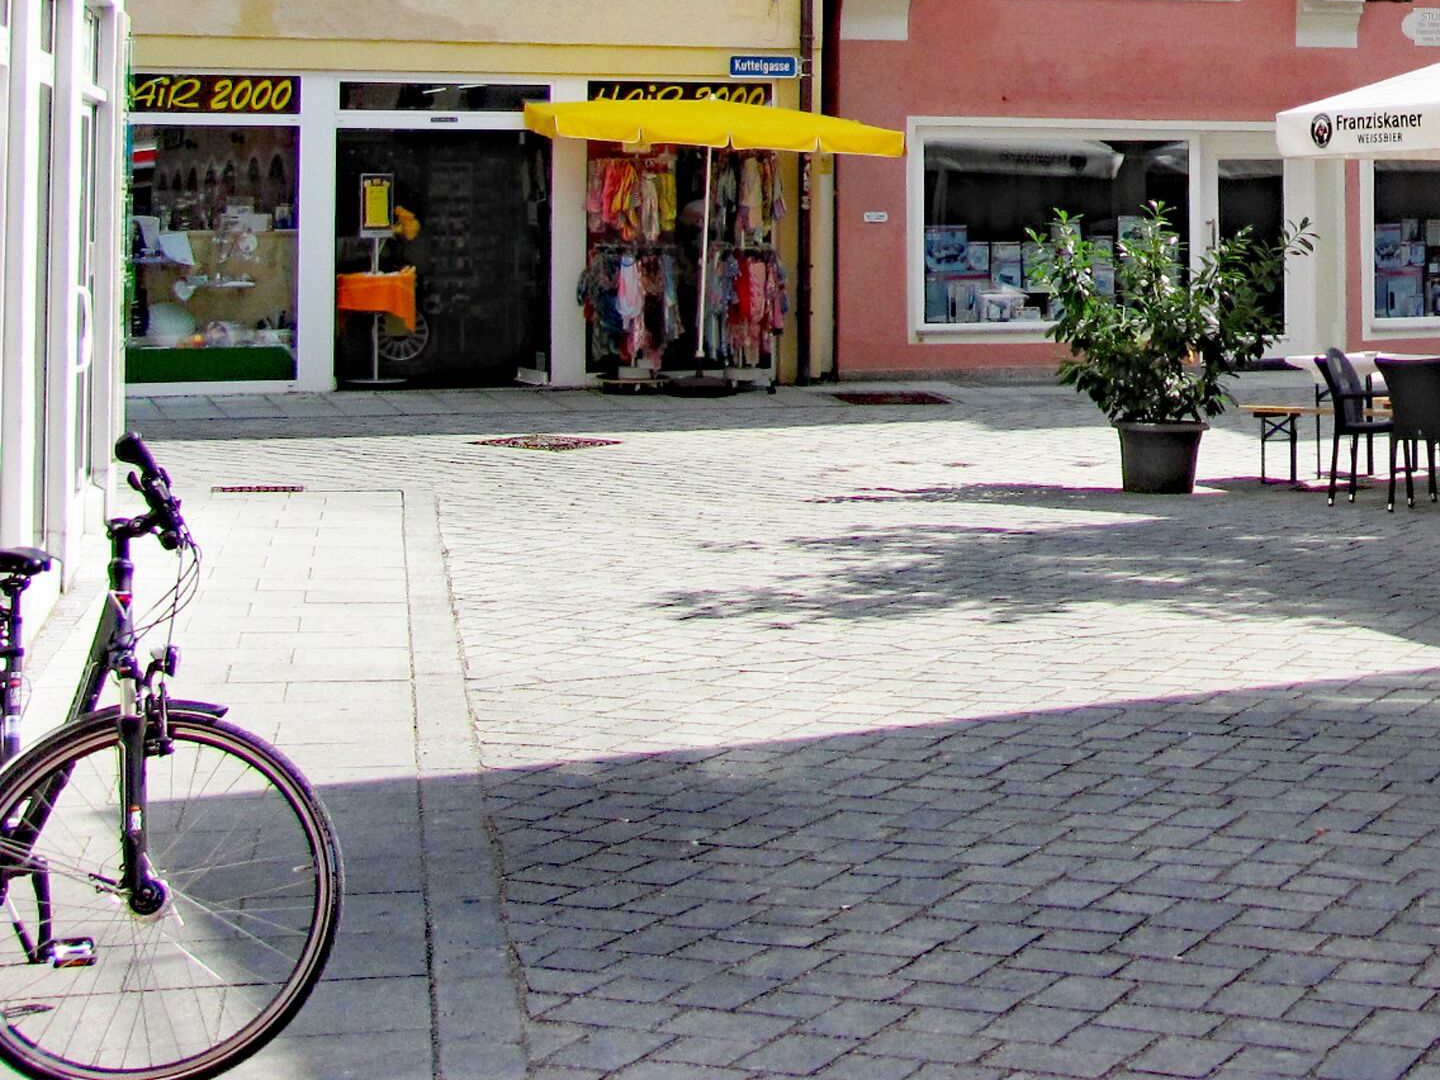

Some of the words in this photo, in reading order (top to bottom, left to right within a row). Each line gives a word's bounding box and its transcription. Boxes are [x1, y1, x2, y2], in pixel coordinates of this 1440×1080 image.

[734, 59, 791, 74] Kuttelgasse
[211, 79, 292, 110] 2000
[1336, 111, 1423, 131] Franziskaner
[1357, 132, 1403, 144] WEISSBIER
